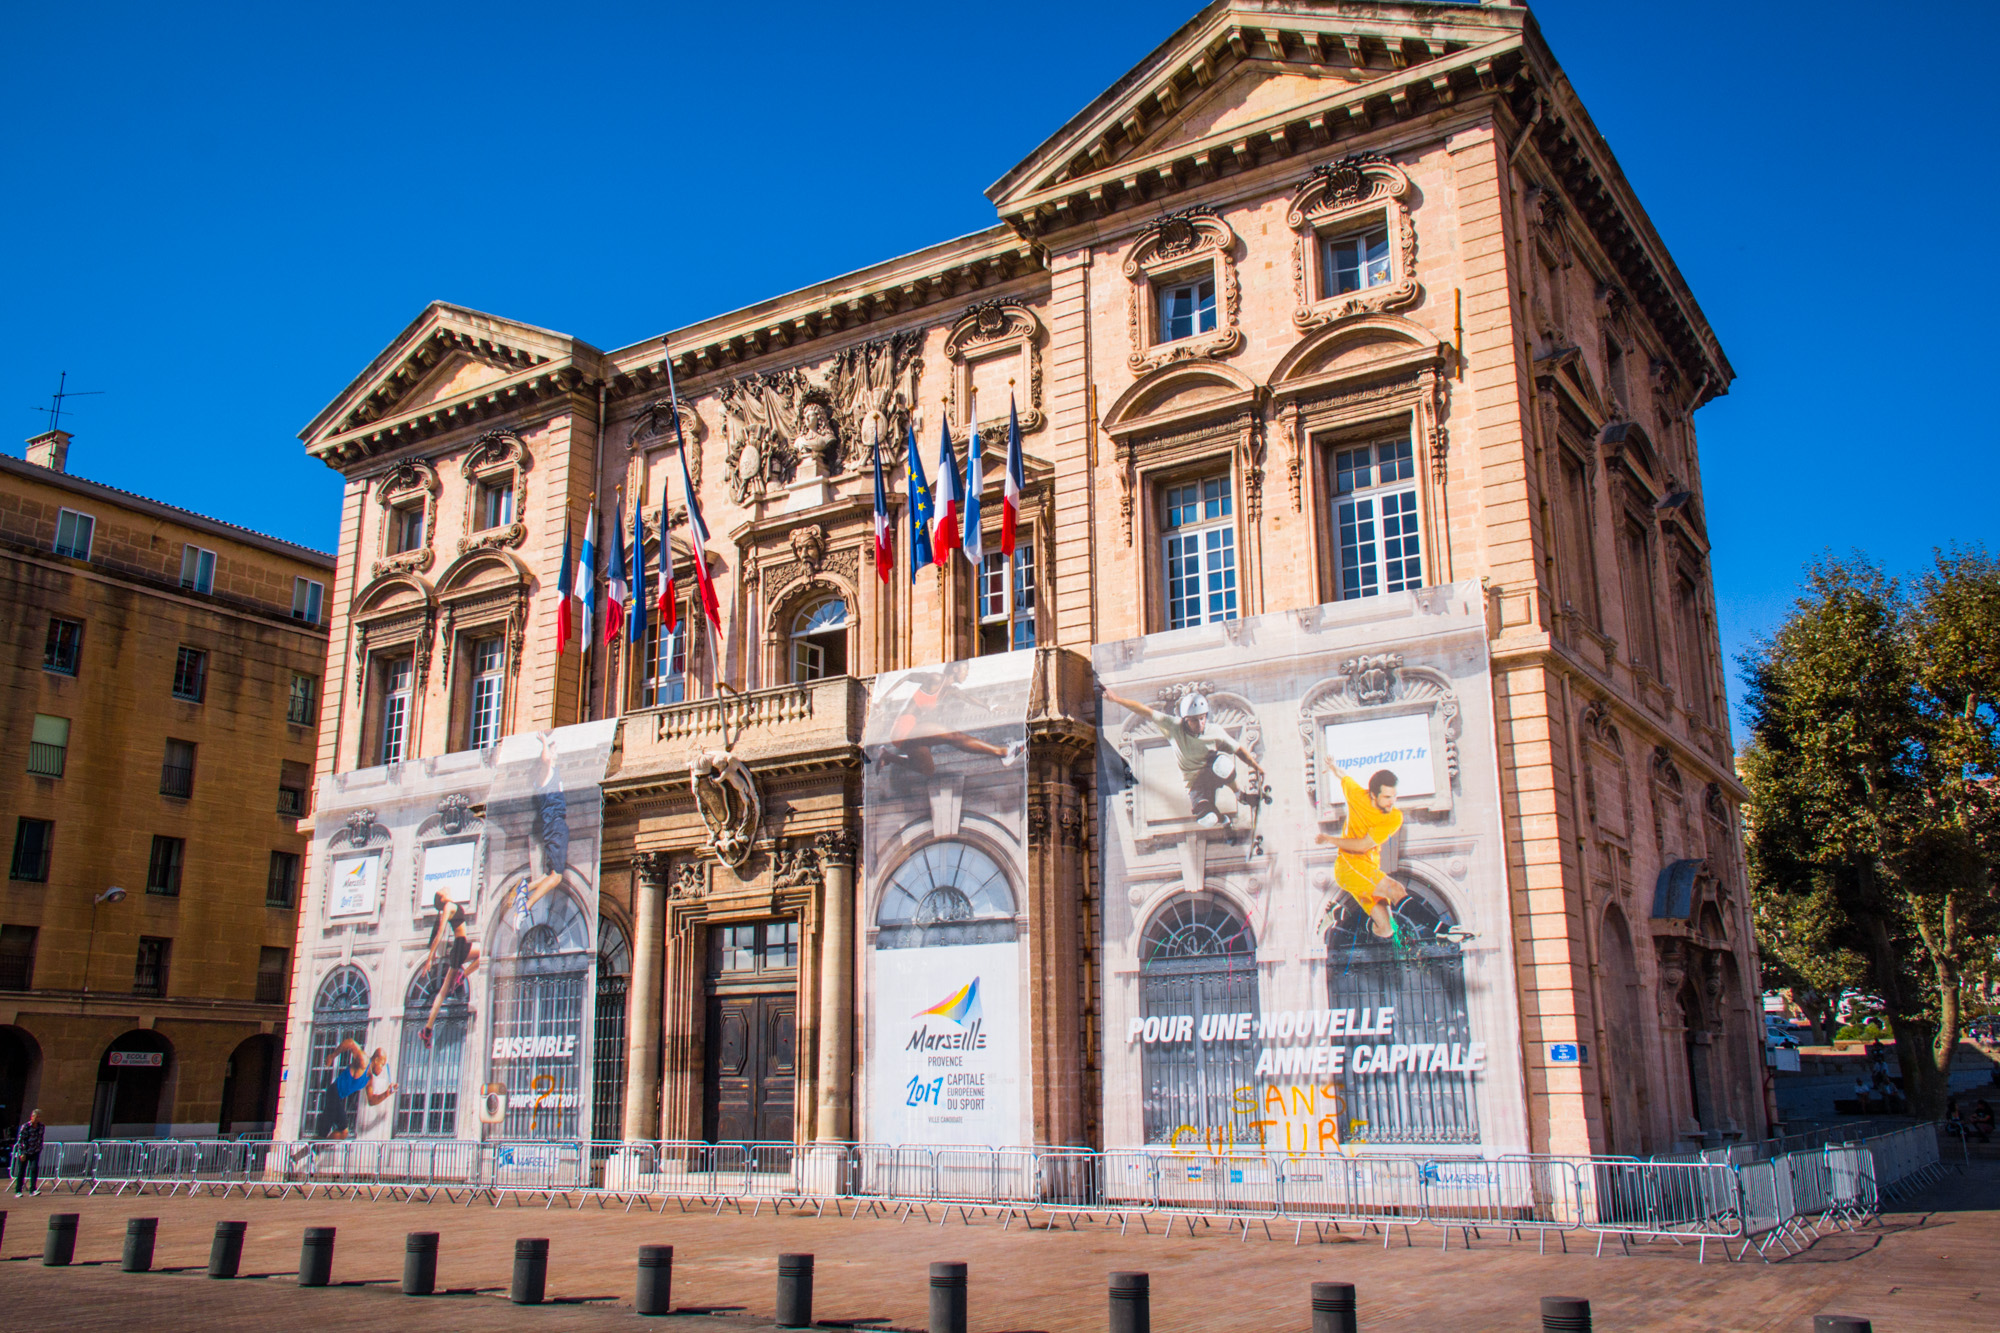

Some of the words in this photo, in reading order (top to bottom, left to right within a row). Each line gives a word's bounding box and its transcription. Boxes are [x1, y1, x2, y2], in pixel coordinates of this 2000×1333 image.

[1336, 747, 1427, 769] mpsport2017.fr
[1127, 1016, 1194, 1043] POUR
[1200, 1013, 1252, 1041] UNE
[1258, 1007, 1394, 1039] NOUVELLE
[492, 1035, 576, 1059] ENSEMBLE
[1255, 1040, 1346, 1075] ANNÉE
[1352, 1042, 1486, 1073] CAPITALE
[928, 1056, 963, 1067] PROVENCE
[906, 1075, 944, 1107] 2017
[947, 1073, 985, 1086] CAPITALE
[947, 1087, 985, 1097] EUROPÉENNE
[1231, 1083, 1347, 1117] SANS
[947, 1098, 957, 1110] DU
[960, 1098, 985, 1110] SPORT
